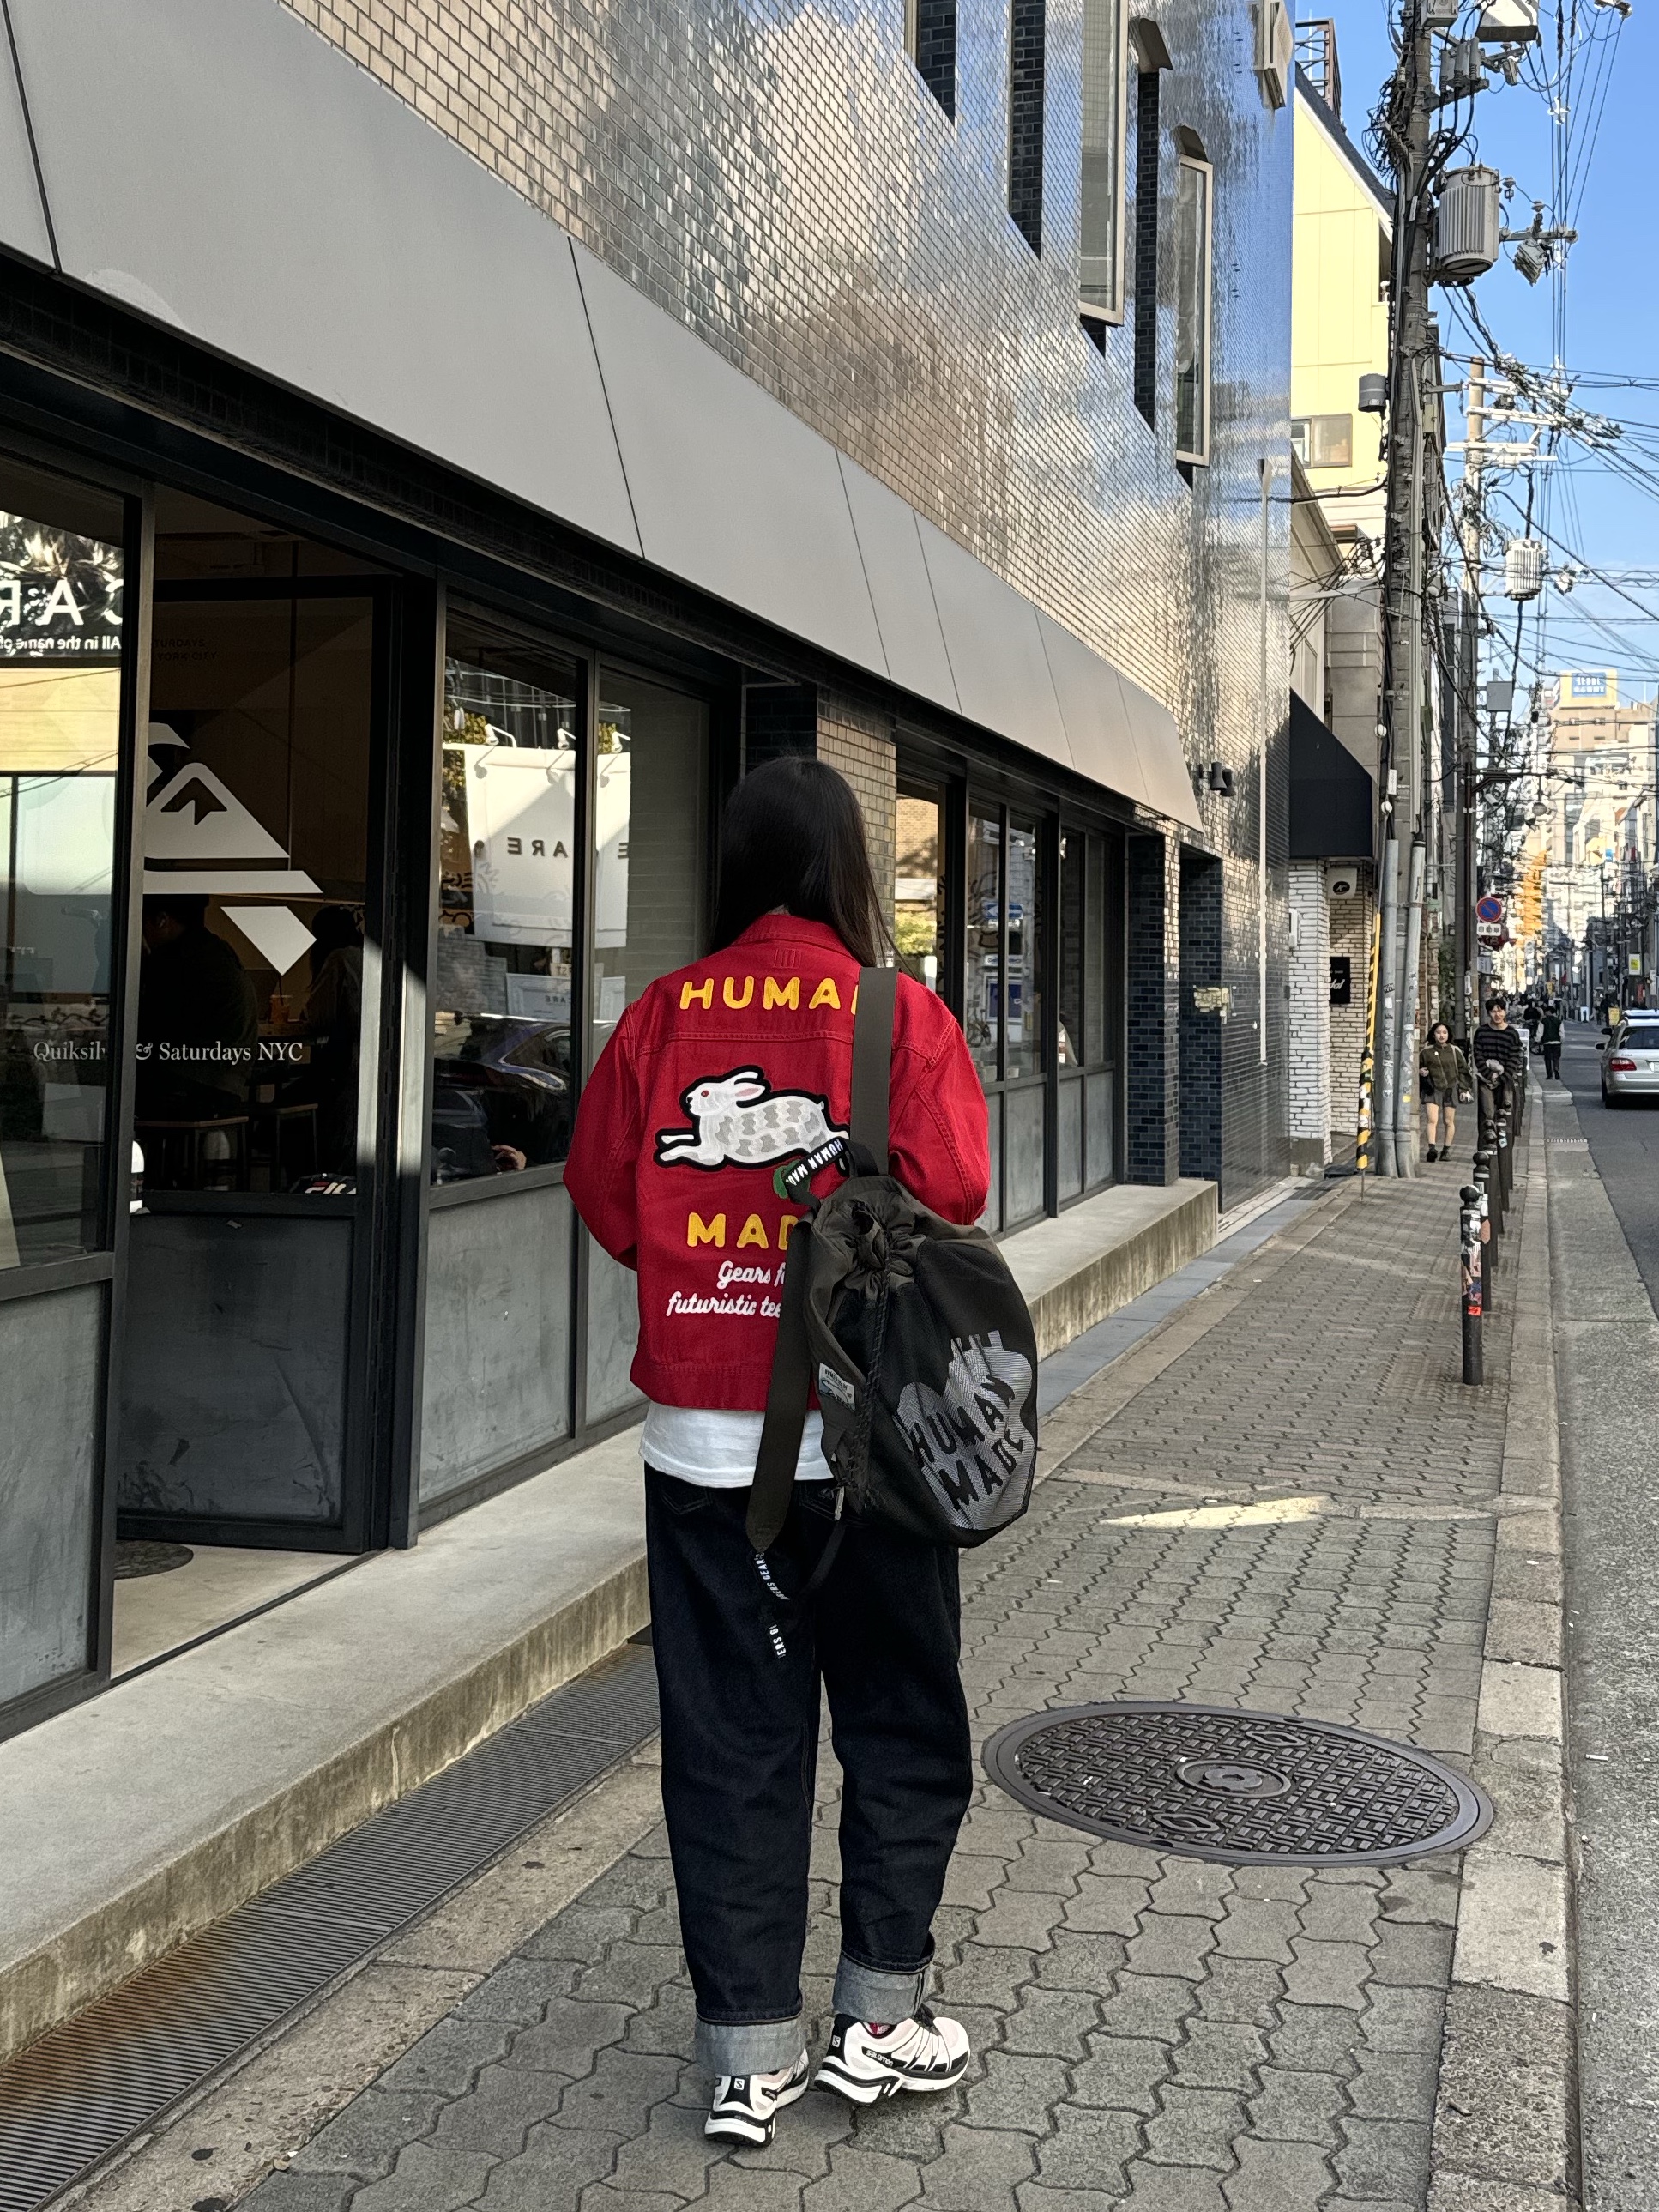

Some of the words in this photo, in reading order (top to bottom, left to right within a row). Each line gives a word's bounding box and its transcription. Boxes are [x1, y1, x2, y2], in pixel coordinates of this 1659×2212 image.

[154, 638, 206, 648] TURDAYS
[680, 976, 859, 1015] HUMA
[136, 1042, 154, 1061] &
[159, 1041, 251, 1066] Saturdays
[257, 1042, 303, 1061] NYC
[807, 1139, 844, 1170] HUMAN
[785, 1163, 809, 1186] MAD
[716, 1260, 771, 1290] Gears
[666, 1290, 757, 1317] futuristic
[910, 1375, 1016, 1469] HUMAN
[938, 1428, 1025, 1512] MADE
